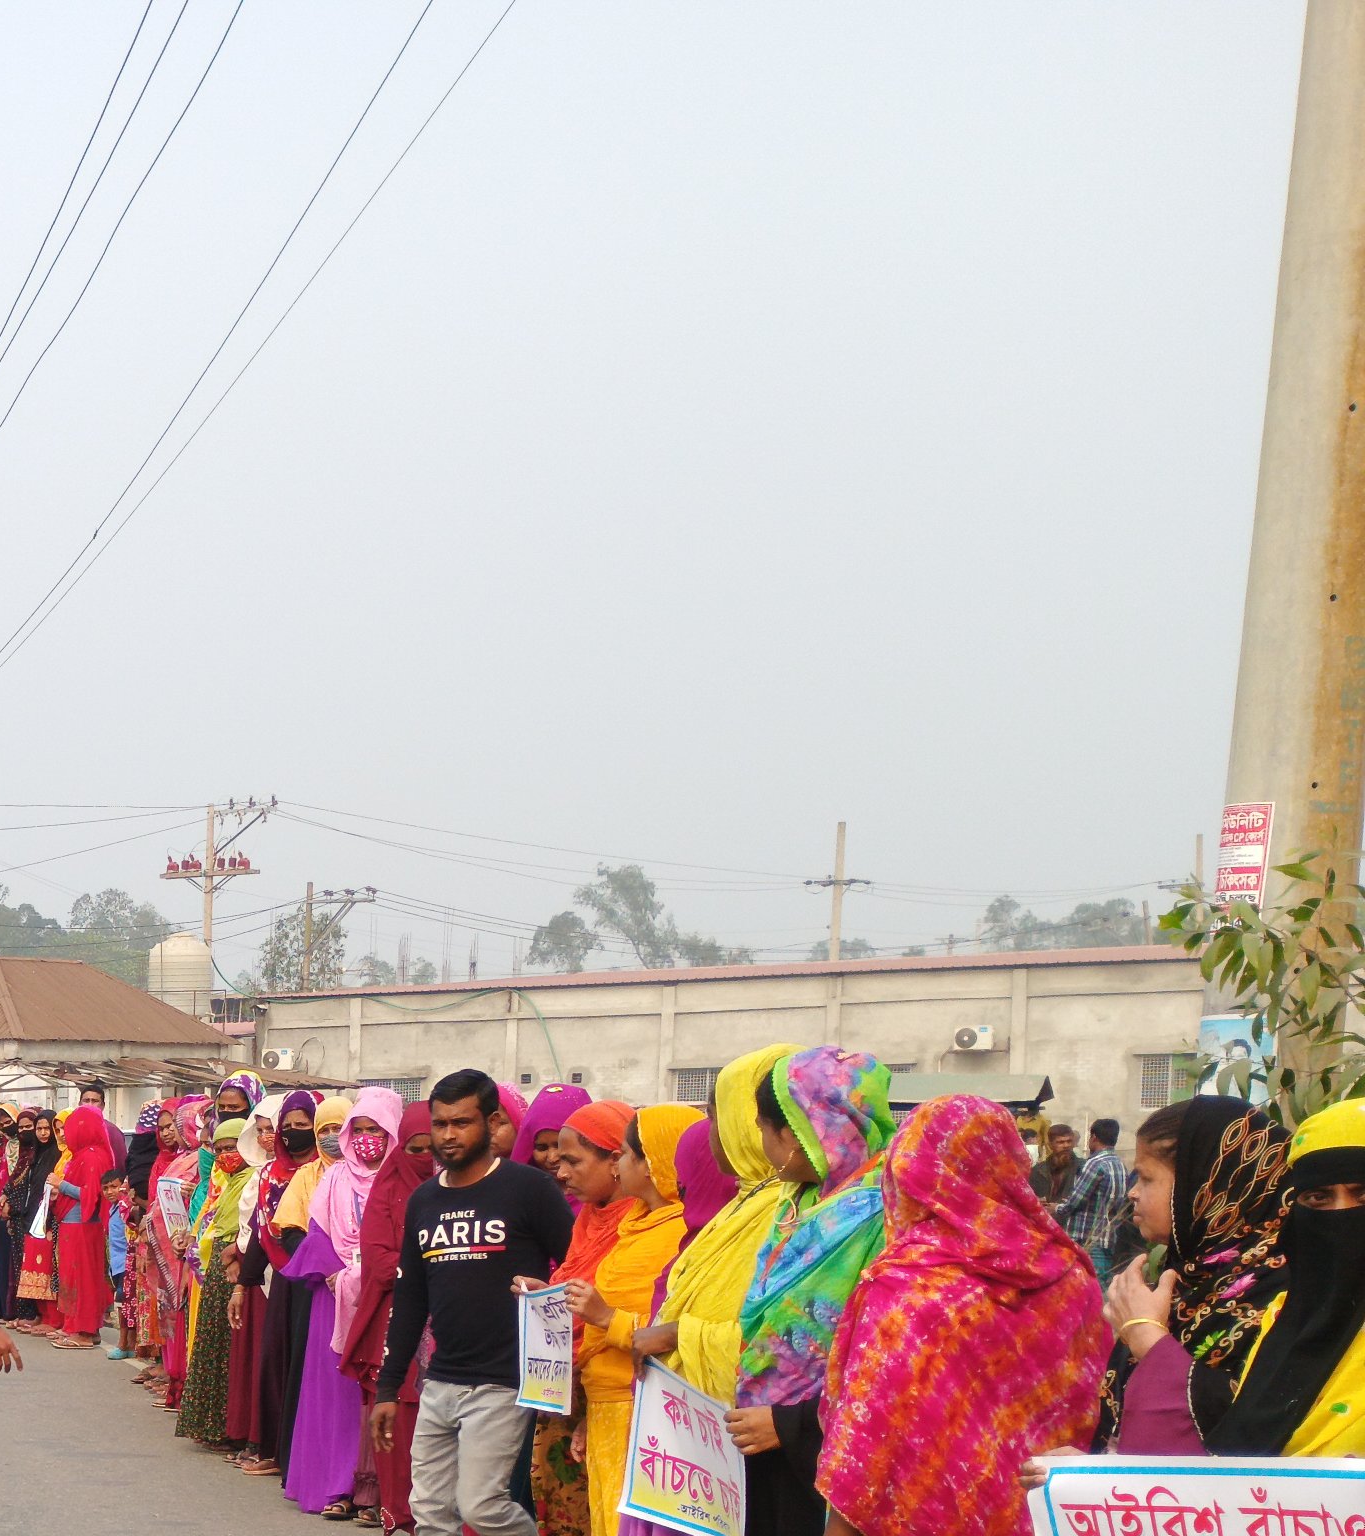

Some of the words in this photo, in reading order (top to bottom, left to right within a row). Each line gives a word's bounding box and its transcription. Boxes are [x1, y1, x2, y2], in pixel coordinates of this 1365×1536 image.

[440, 1210, 476, 1221] FRANCE
[418, 1220, 506, 1250] PARIS
[639, 1435, 714, 1501] বাঁচতে
